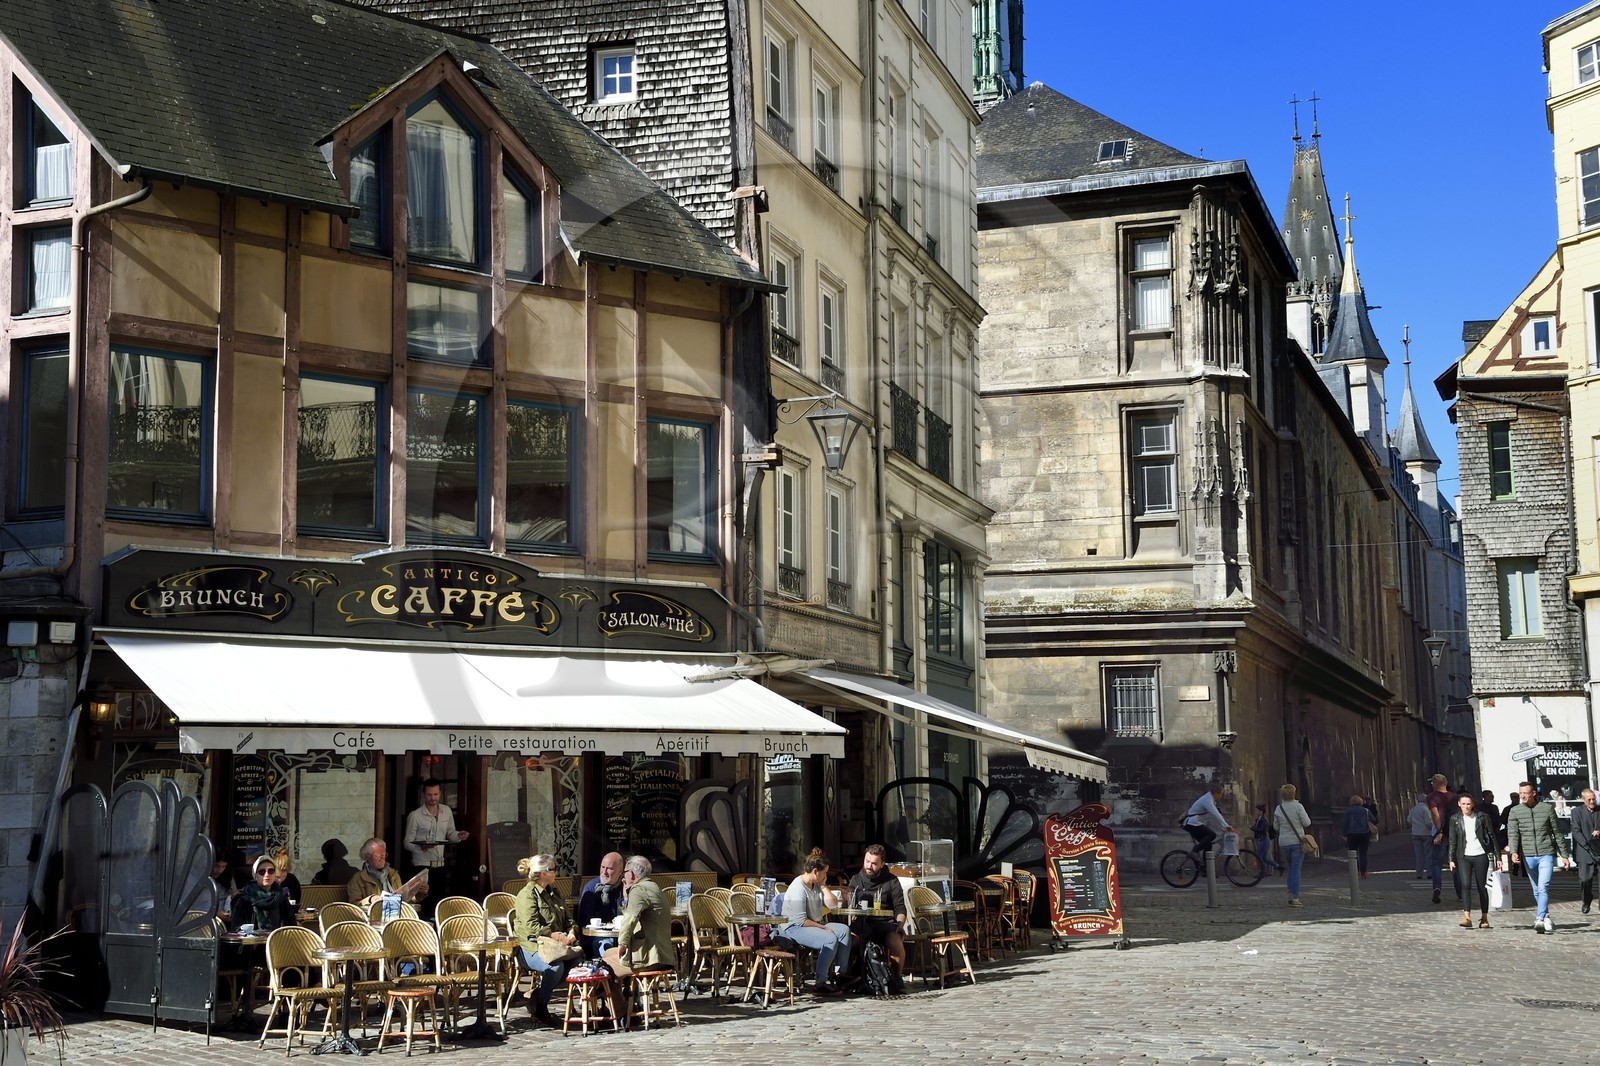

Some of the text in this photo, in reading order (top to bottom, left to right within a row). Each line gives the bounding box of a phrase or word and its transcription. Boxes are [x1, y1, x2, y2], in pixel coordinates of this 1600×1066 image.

[403, 568, 497, 585] ANTICO
[159, 589, 264, 608] BRUNCH
[607, 611, 660, 628] SALON
[333, 731, 808, 752] Café Petite restauration Apéritif Brunch
[1539, 759, 1587, 768] ANTALONS,...
[1546, 767, 1577, 775] EN CUIR
[1062, 815, 1099, 831] Antico
[1051, 824, 1097, 846] Caffé
